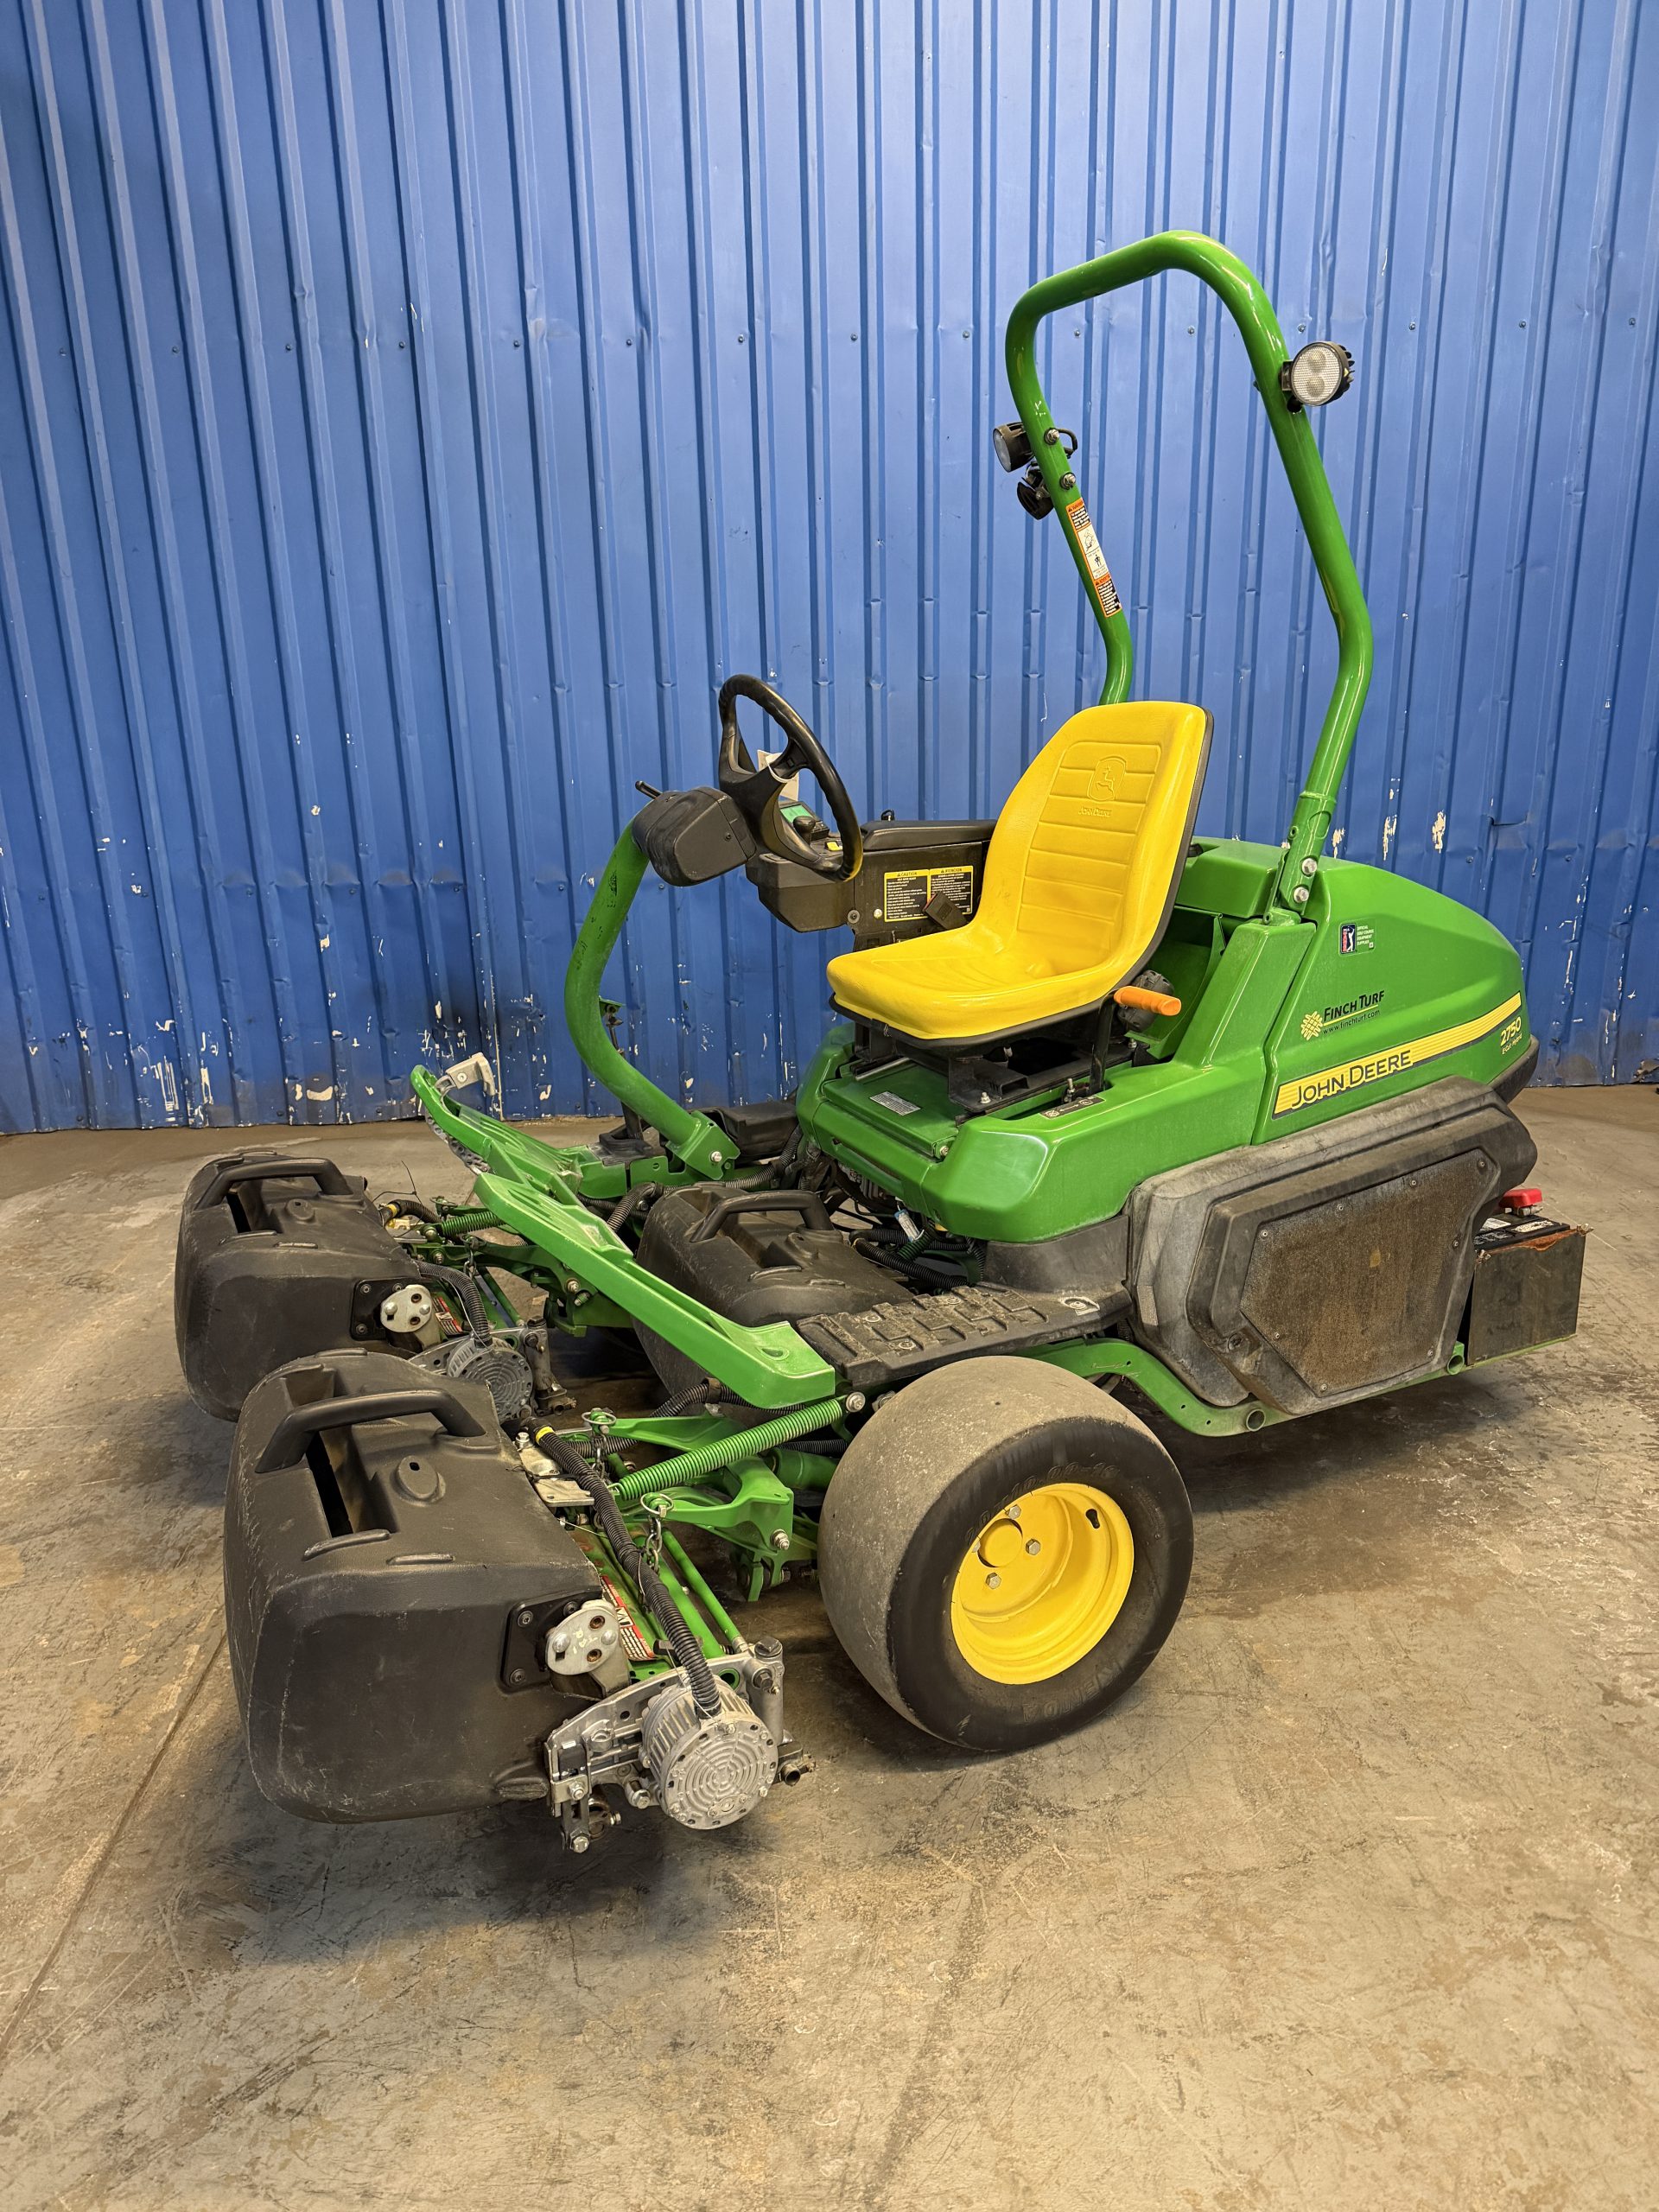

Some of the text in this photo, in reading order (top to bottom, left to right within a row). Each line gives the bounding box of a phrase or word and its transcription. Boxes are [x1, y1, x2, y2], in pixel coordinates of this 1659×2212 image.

[1324, 990, 1385, 1022] FINCH TURF
[1323, 1010, 1380, 1035] www.finchturf.com
[1500, 1016, 1522, 1046] 2750
[1293, 1050, 1412, 1108] JOHN DEERE
